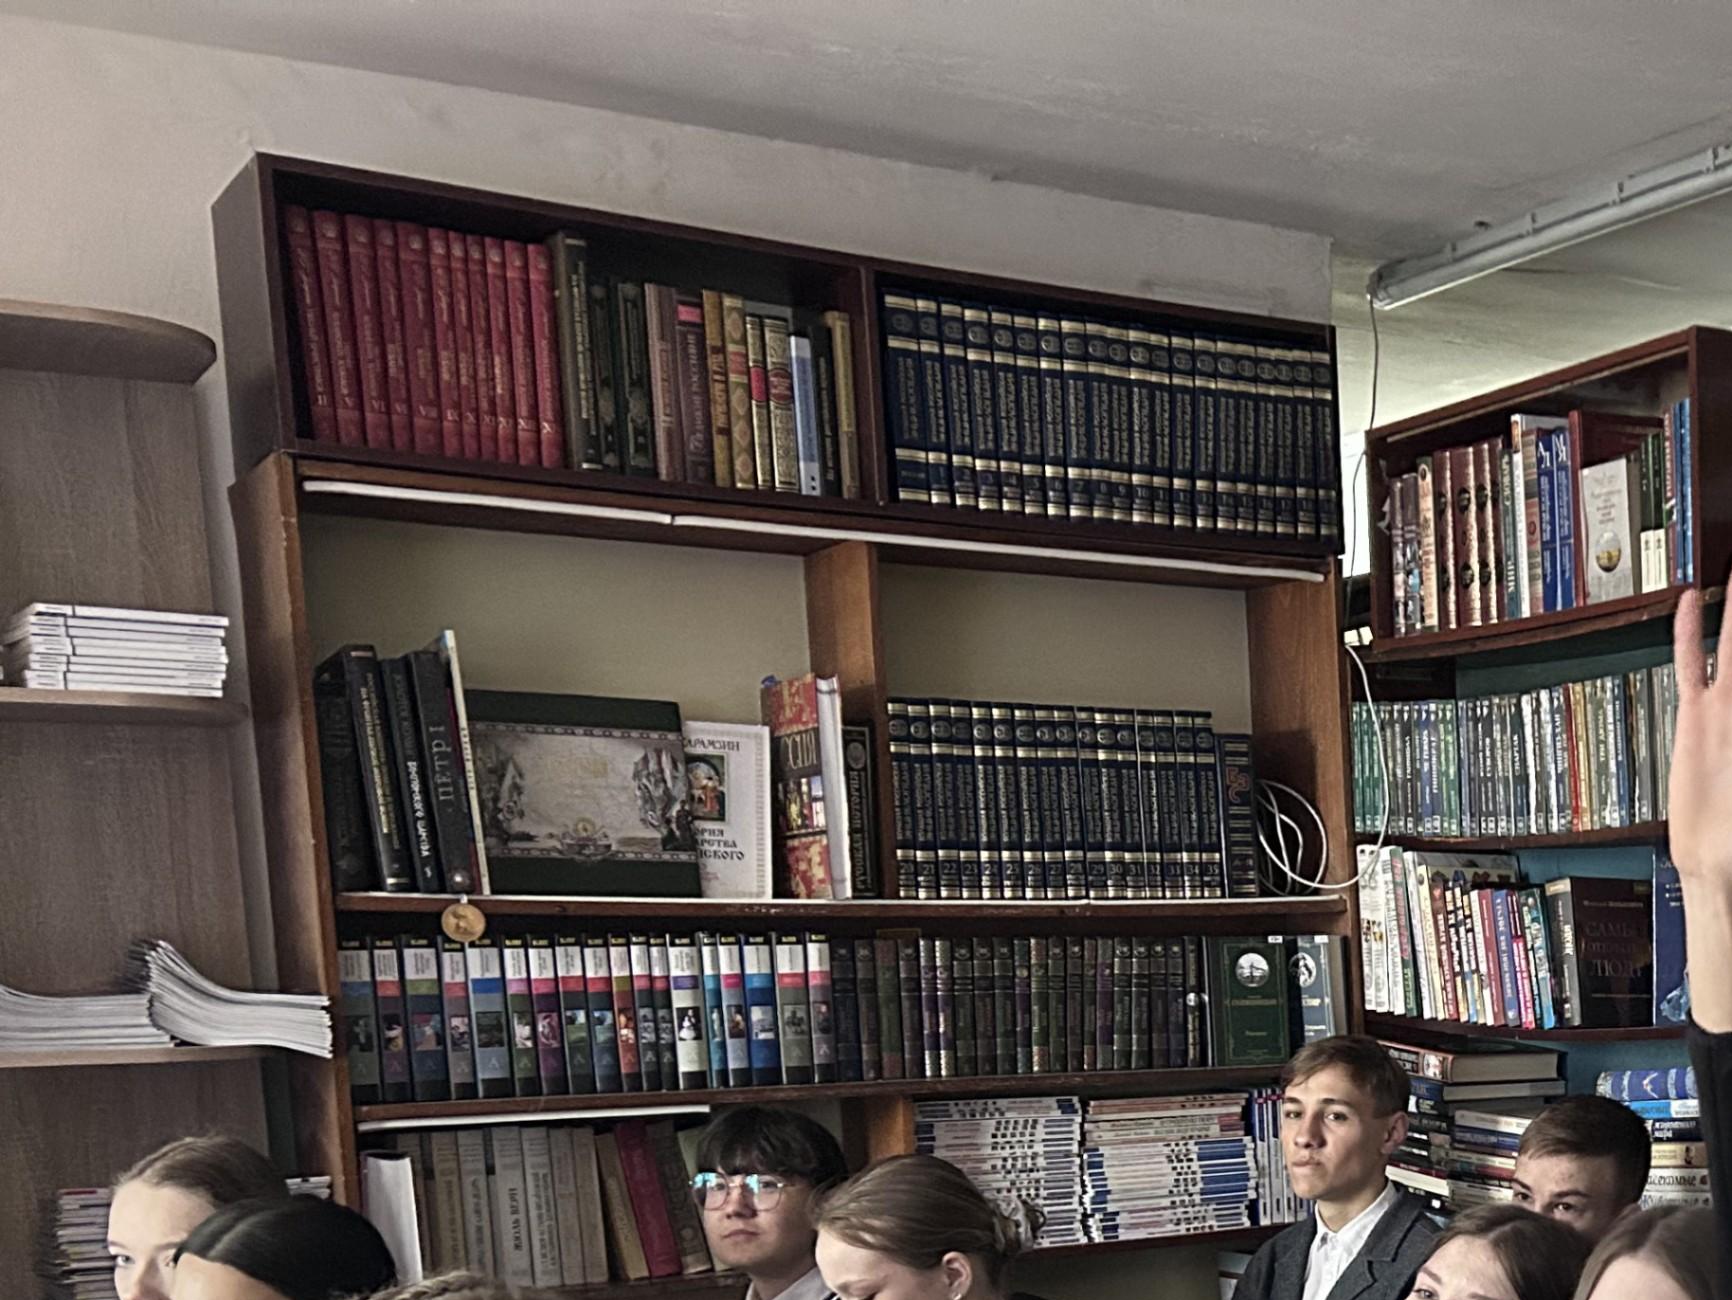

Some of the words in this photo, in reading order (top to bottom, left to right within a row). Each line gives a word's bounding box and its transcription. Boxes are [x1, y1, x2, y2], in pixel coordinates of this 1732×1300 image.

[1110, 863, 1123, 874] 30
[1129, 864, 1141, 875] 31
[1207, 864, 1219, 875] 35
